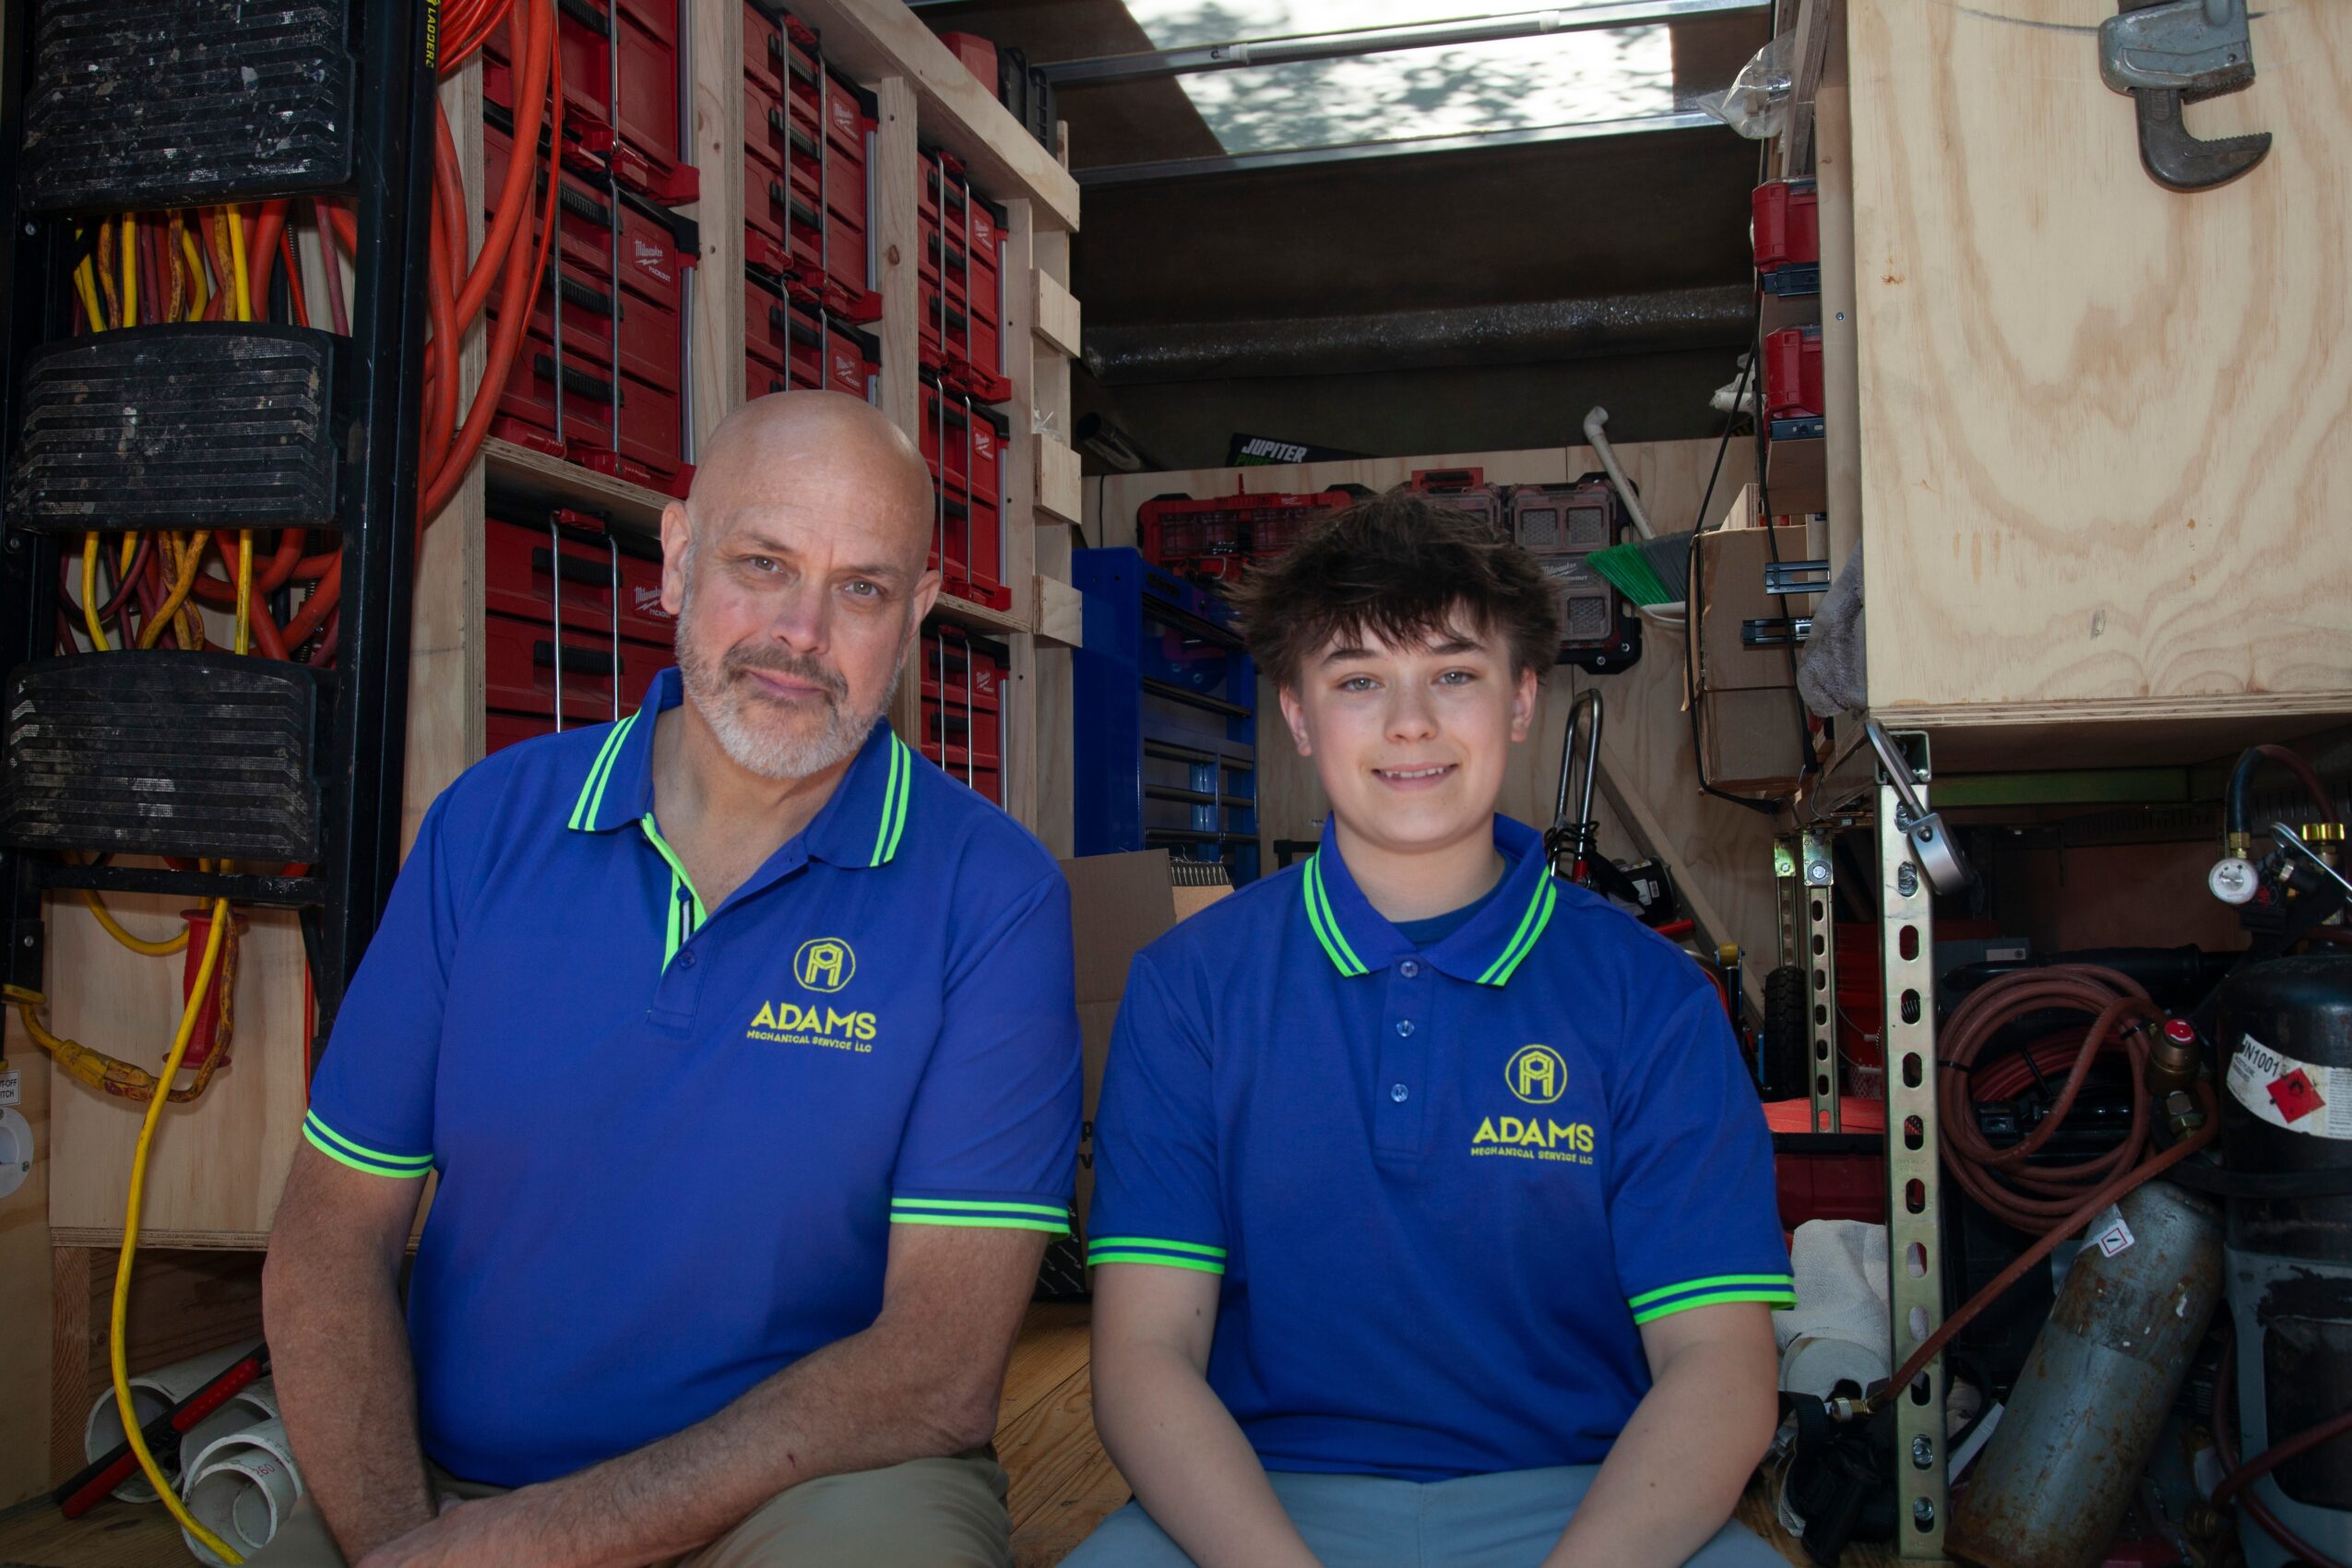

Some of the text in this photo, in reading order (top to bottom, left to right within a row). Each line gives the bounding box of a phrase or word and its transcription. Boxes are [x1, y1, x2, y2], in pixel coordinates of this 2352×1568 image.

[1241, 438, 1308, 463] JUPITER
[750, 1000, 877, 1040] ADAMS
[746, 1029, 872, 1052] MECHANICAL SERVICE LLC
[1472, 1116, 1595, 1153] ADAMS
[1470, 1146, 1593, 1165] MECHANICAL SERVICE LLC
